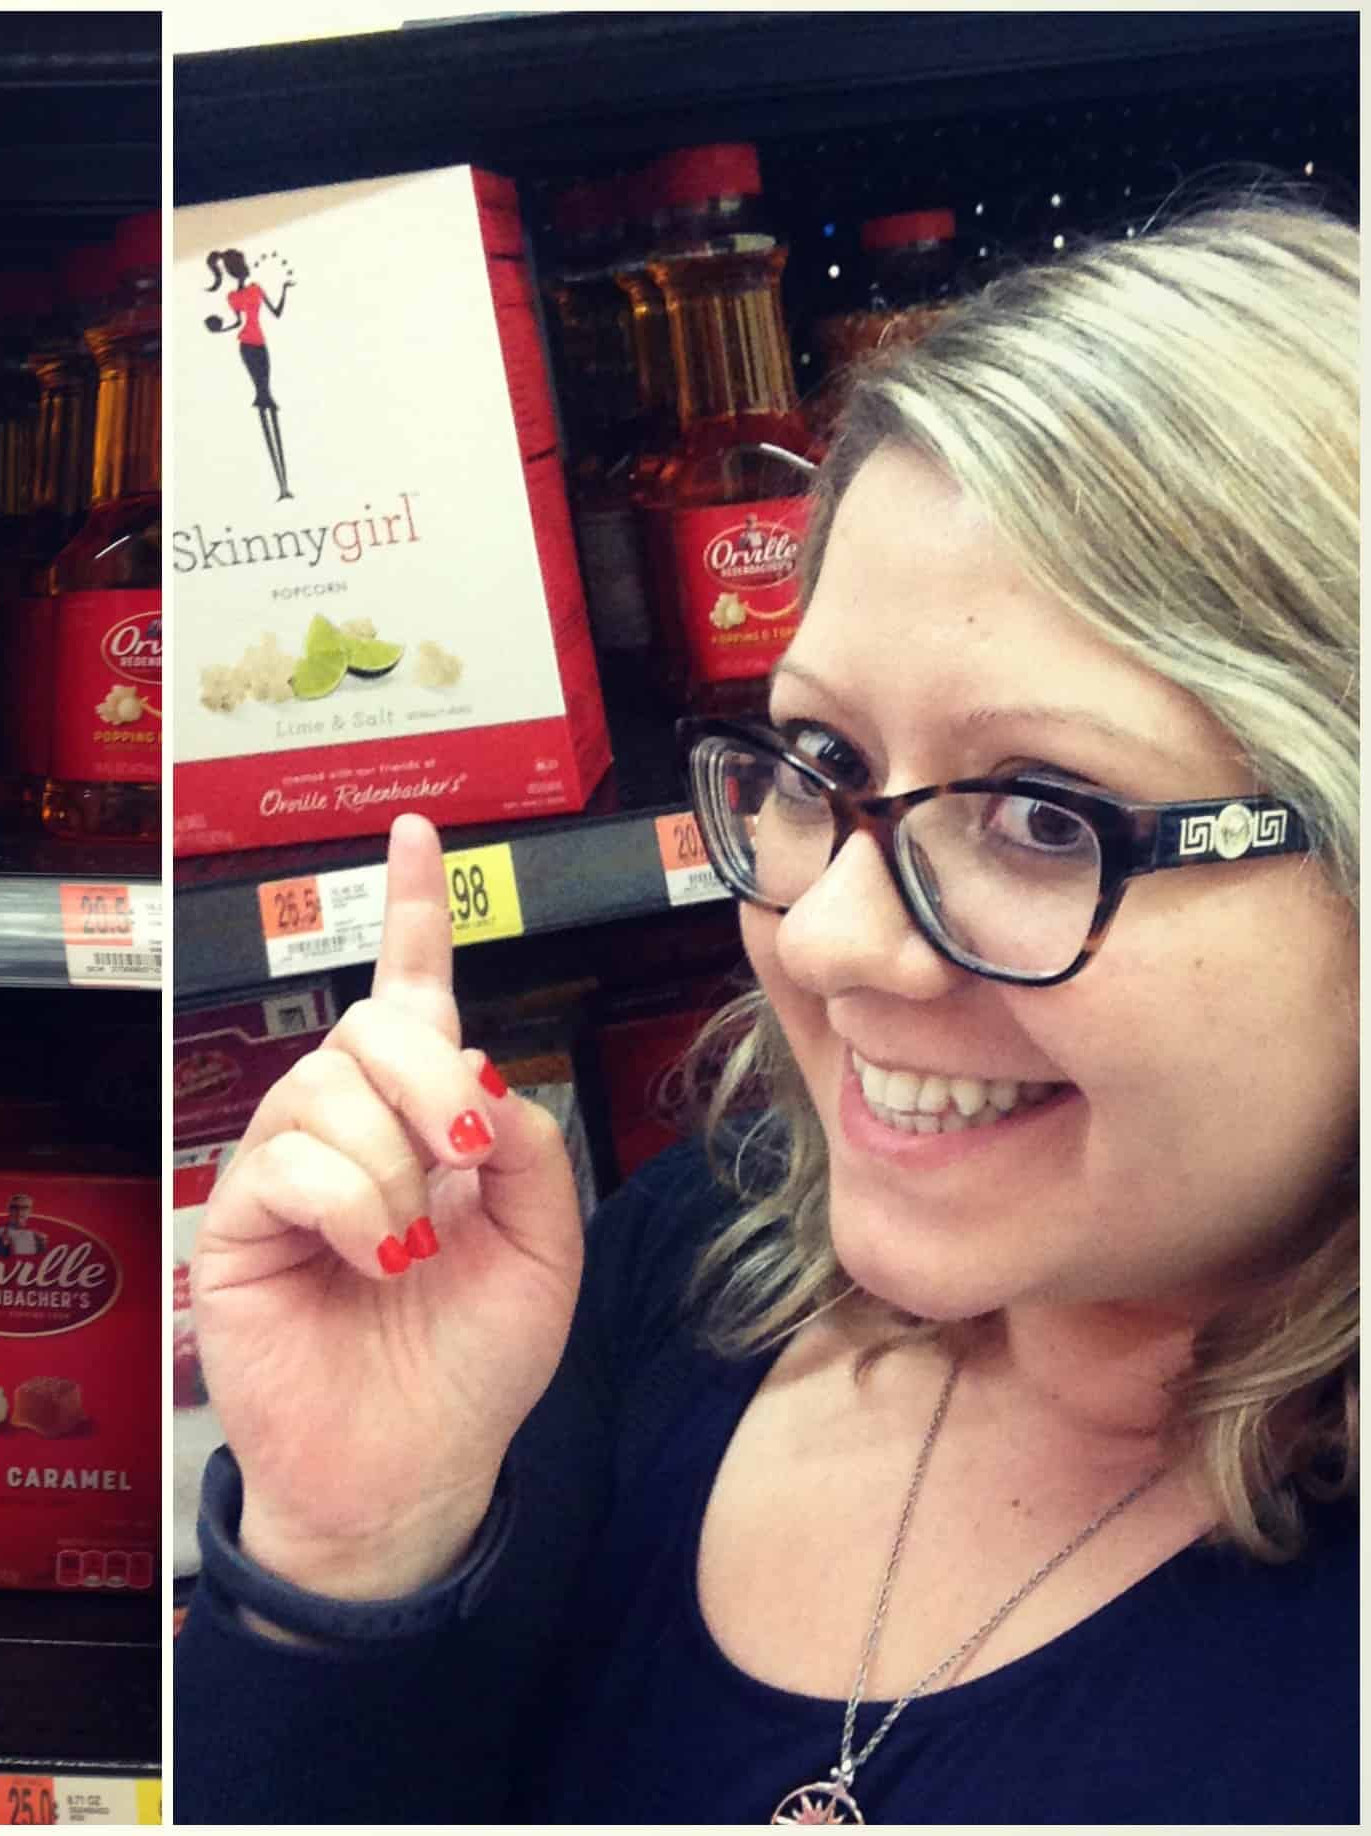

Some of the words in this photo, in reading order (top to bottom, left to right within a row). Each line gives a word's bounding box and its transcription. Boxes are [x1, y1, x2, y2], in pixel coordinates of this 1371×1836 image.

[173, 493, 421, 573] Skinnygirl
[711, 530, 797, 569] Orville
[271, 581, 349, 601] POPCORN
[93, 731, 155, 743] POPPING
[276, 719, 324, 739] Lime
[353, 709, 395, 728] Salt
[260, 790, 328, 817] Orville
[7, 1466, 132, 1490] CARAMEL
